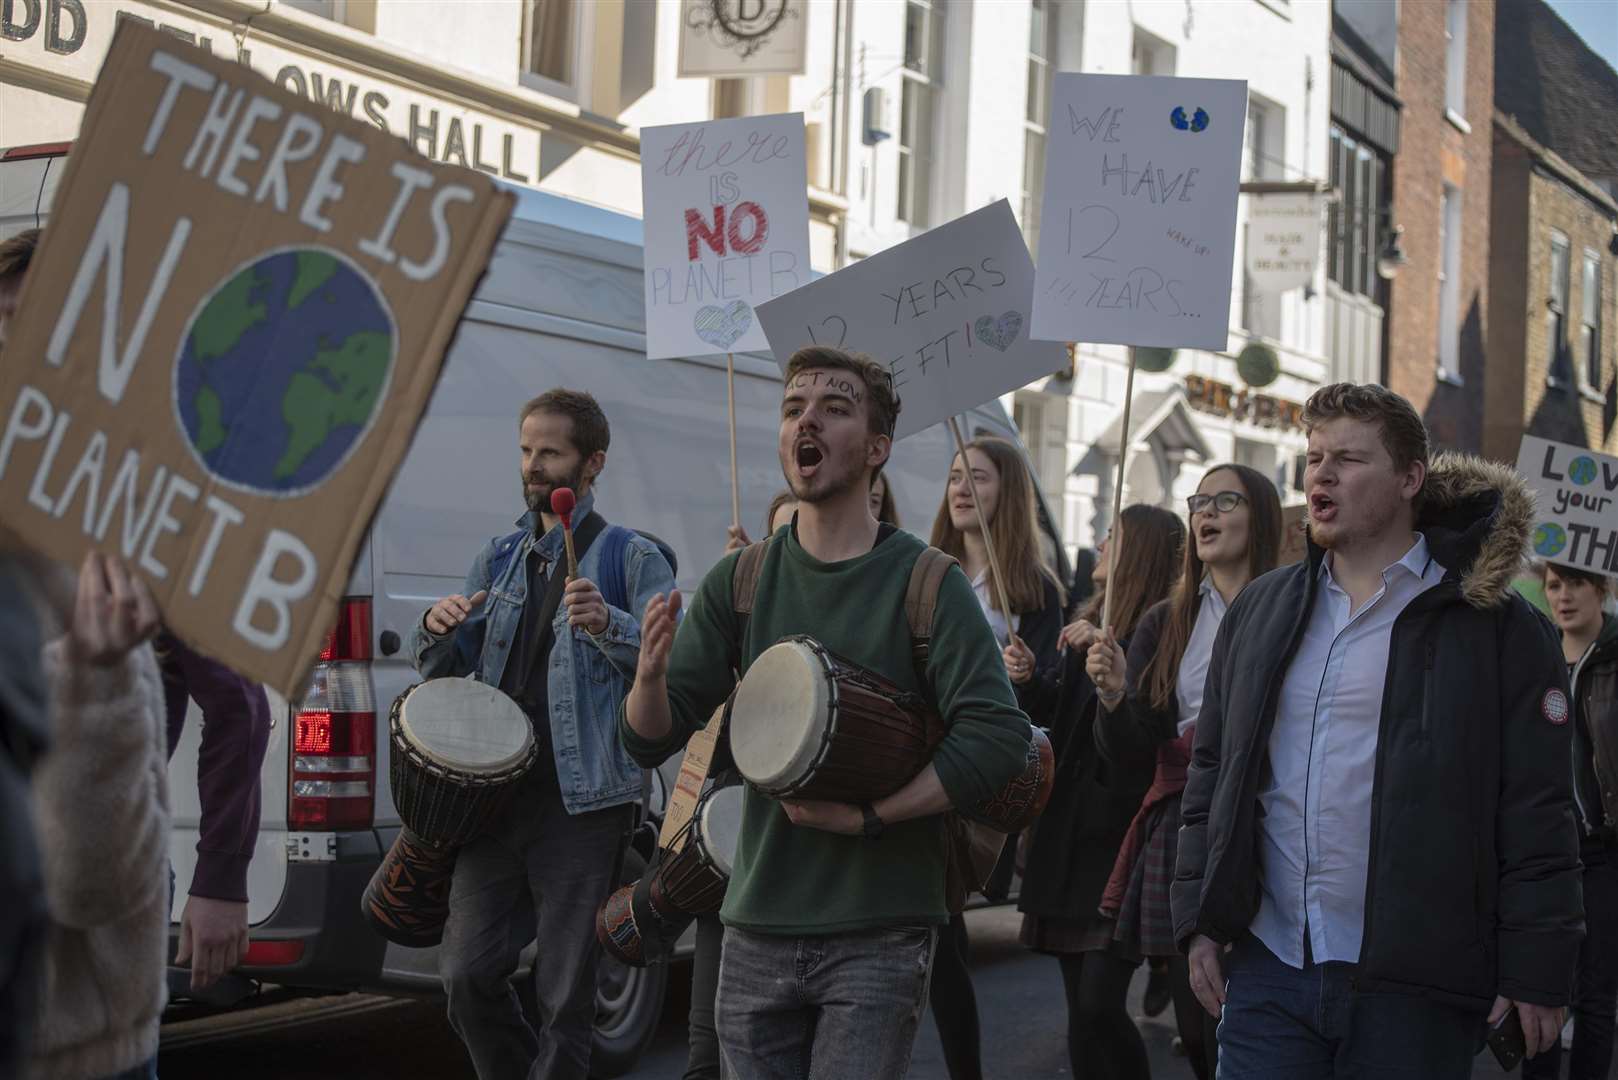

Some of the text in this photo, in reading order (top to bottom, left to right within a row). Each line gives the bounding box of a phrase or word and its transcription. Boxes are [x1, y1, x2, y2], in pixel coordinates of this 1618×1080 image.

[409, 103, 528, 183] HALL
[1067, 104, 1124, 142] WE
[144, 49, 366, 232] THERE
[358, 162, 475, 281] IS
[656, 127, 791, 176] there
[1101, 153, 1200, 204] HAVE
[709, 171, 741, 206] IS
[684, 201, 769, 262] NO
[1067, 205, 1120, 262] 12
[652, 250, 800, 306] PLANET B
[880, 257, 1006, 325] YEARS
[888, 321, 974, 389] EFT!
[825, 377, 865, 403] NOW
[0, 386, 318, 652] PLANET B
[1552, 488, 1612, 515] your
